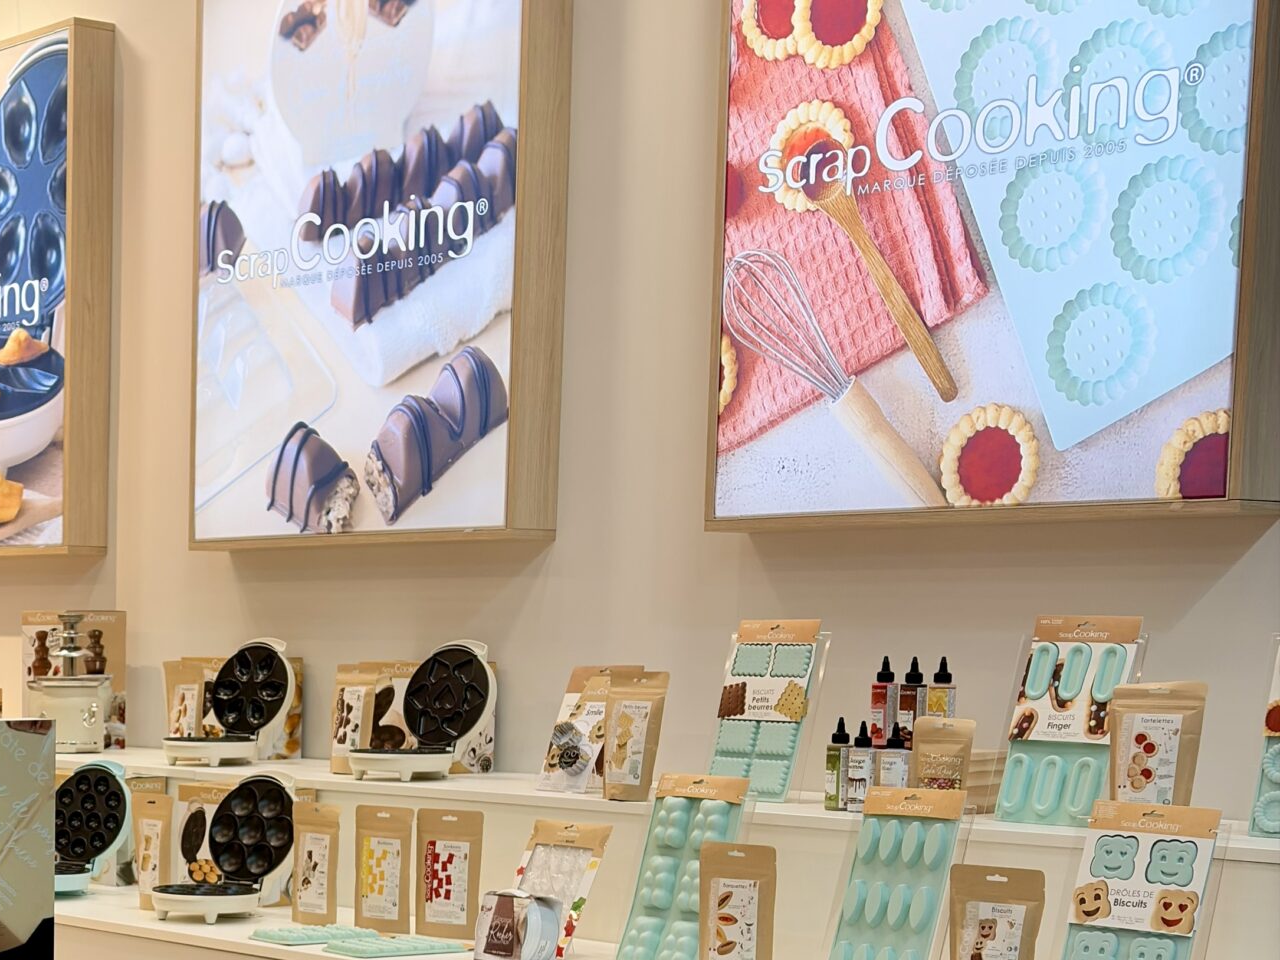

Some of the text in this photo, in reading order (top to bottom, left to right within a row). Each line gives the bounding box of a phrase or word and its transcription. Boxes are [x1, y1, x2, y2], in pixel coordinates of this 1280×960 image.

[857, 138, 1128, 195] MARQUE DÉPOSÉE DEPUIS 2005
[377, 257, 413, 273] DEPUIS
[418, 252, 443, 266] 2005
[1047, 722, 1071, 731] Finger
[1110, 888, 1155, 899] DRÔLES DE
[1113, 899, 1148, 909] Biscuits
[992, 906, 1013, 914] Biscuits
